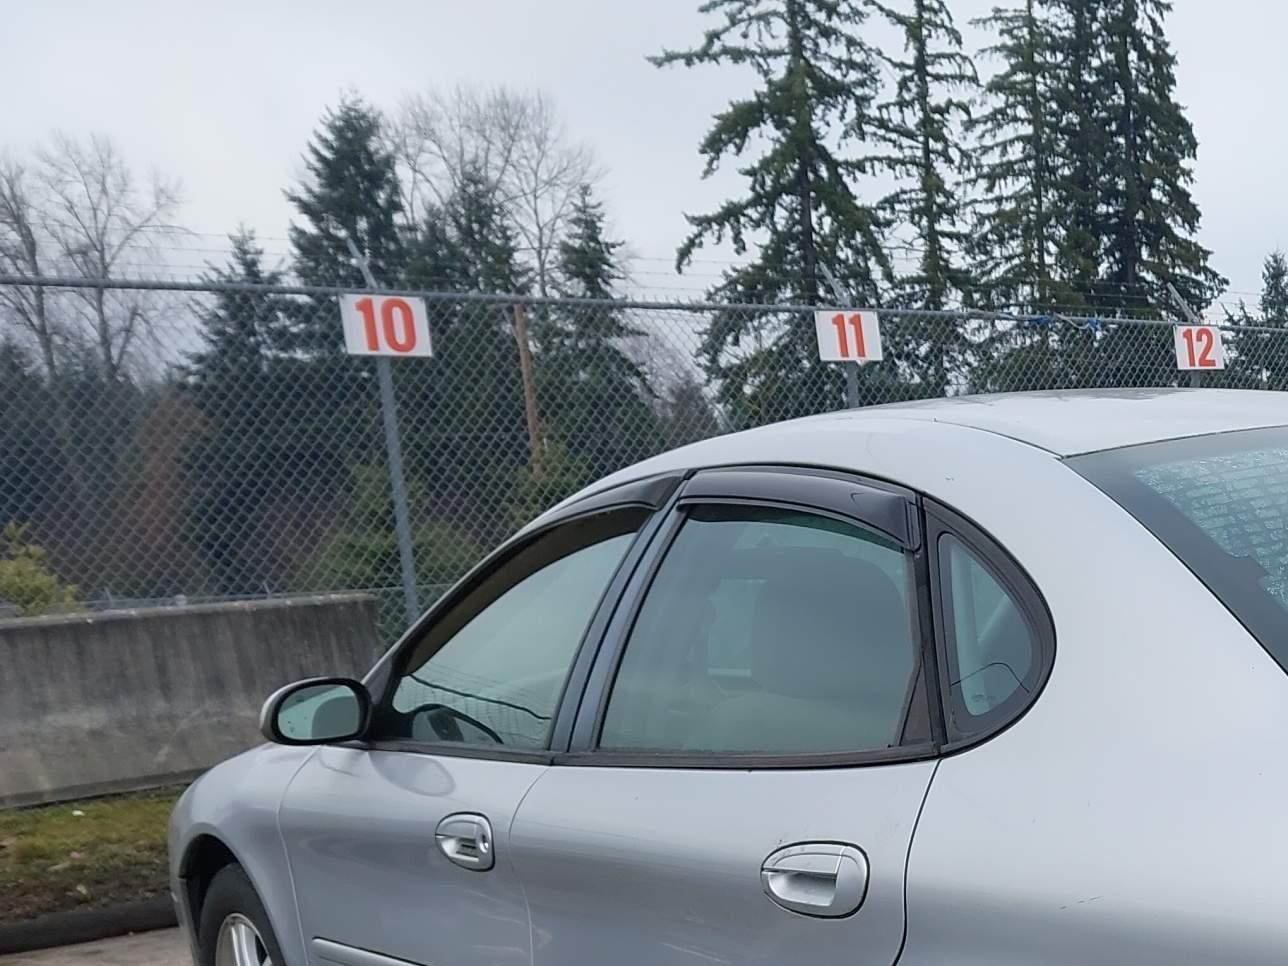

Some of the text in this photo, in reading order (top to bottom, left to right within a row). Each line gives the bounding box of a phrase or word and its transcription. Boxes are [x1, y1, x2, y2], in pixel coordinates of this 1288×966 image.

[354, 296, 417, 354] 10
[831, 312, 866, 358] 11
[1182, 327, 1217, 367] 12
